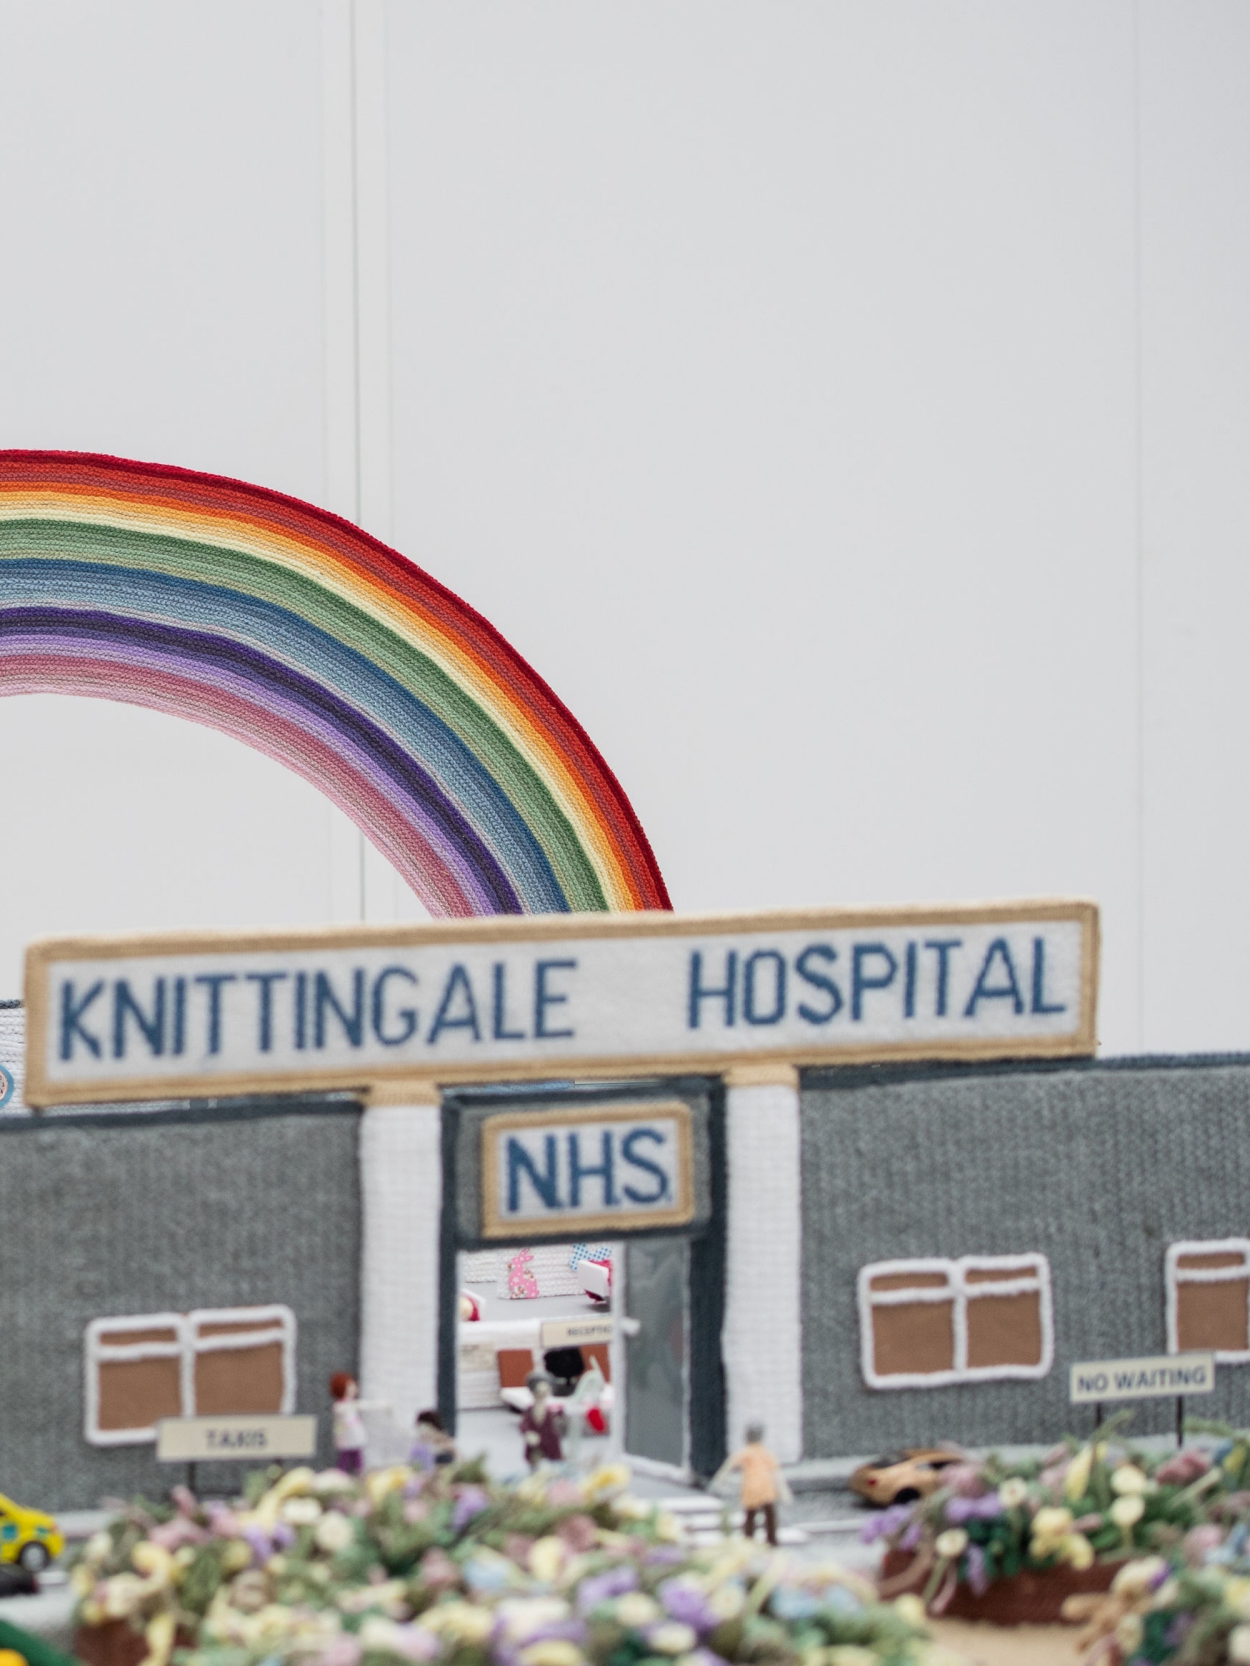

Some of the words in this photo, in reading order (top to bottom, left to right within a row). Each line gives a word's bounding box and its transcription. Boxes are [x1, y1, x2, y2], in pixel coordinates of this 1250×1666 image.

[58, 956, 579, 1064] KNITTINGALE
[686, 936, 1068, 1030] HOSPITAL
[504, 1127, 671, 1214] NHS
[566, 1324, 614, 1336] RECEPTIO
[1077, 1373, 1109, 1393] NO
[1114, 1365, 1207, 1389] WAITING
[206, 1428, 268, 1448] TAXIS
